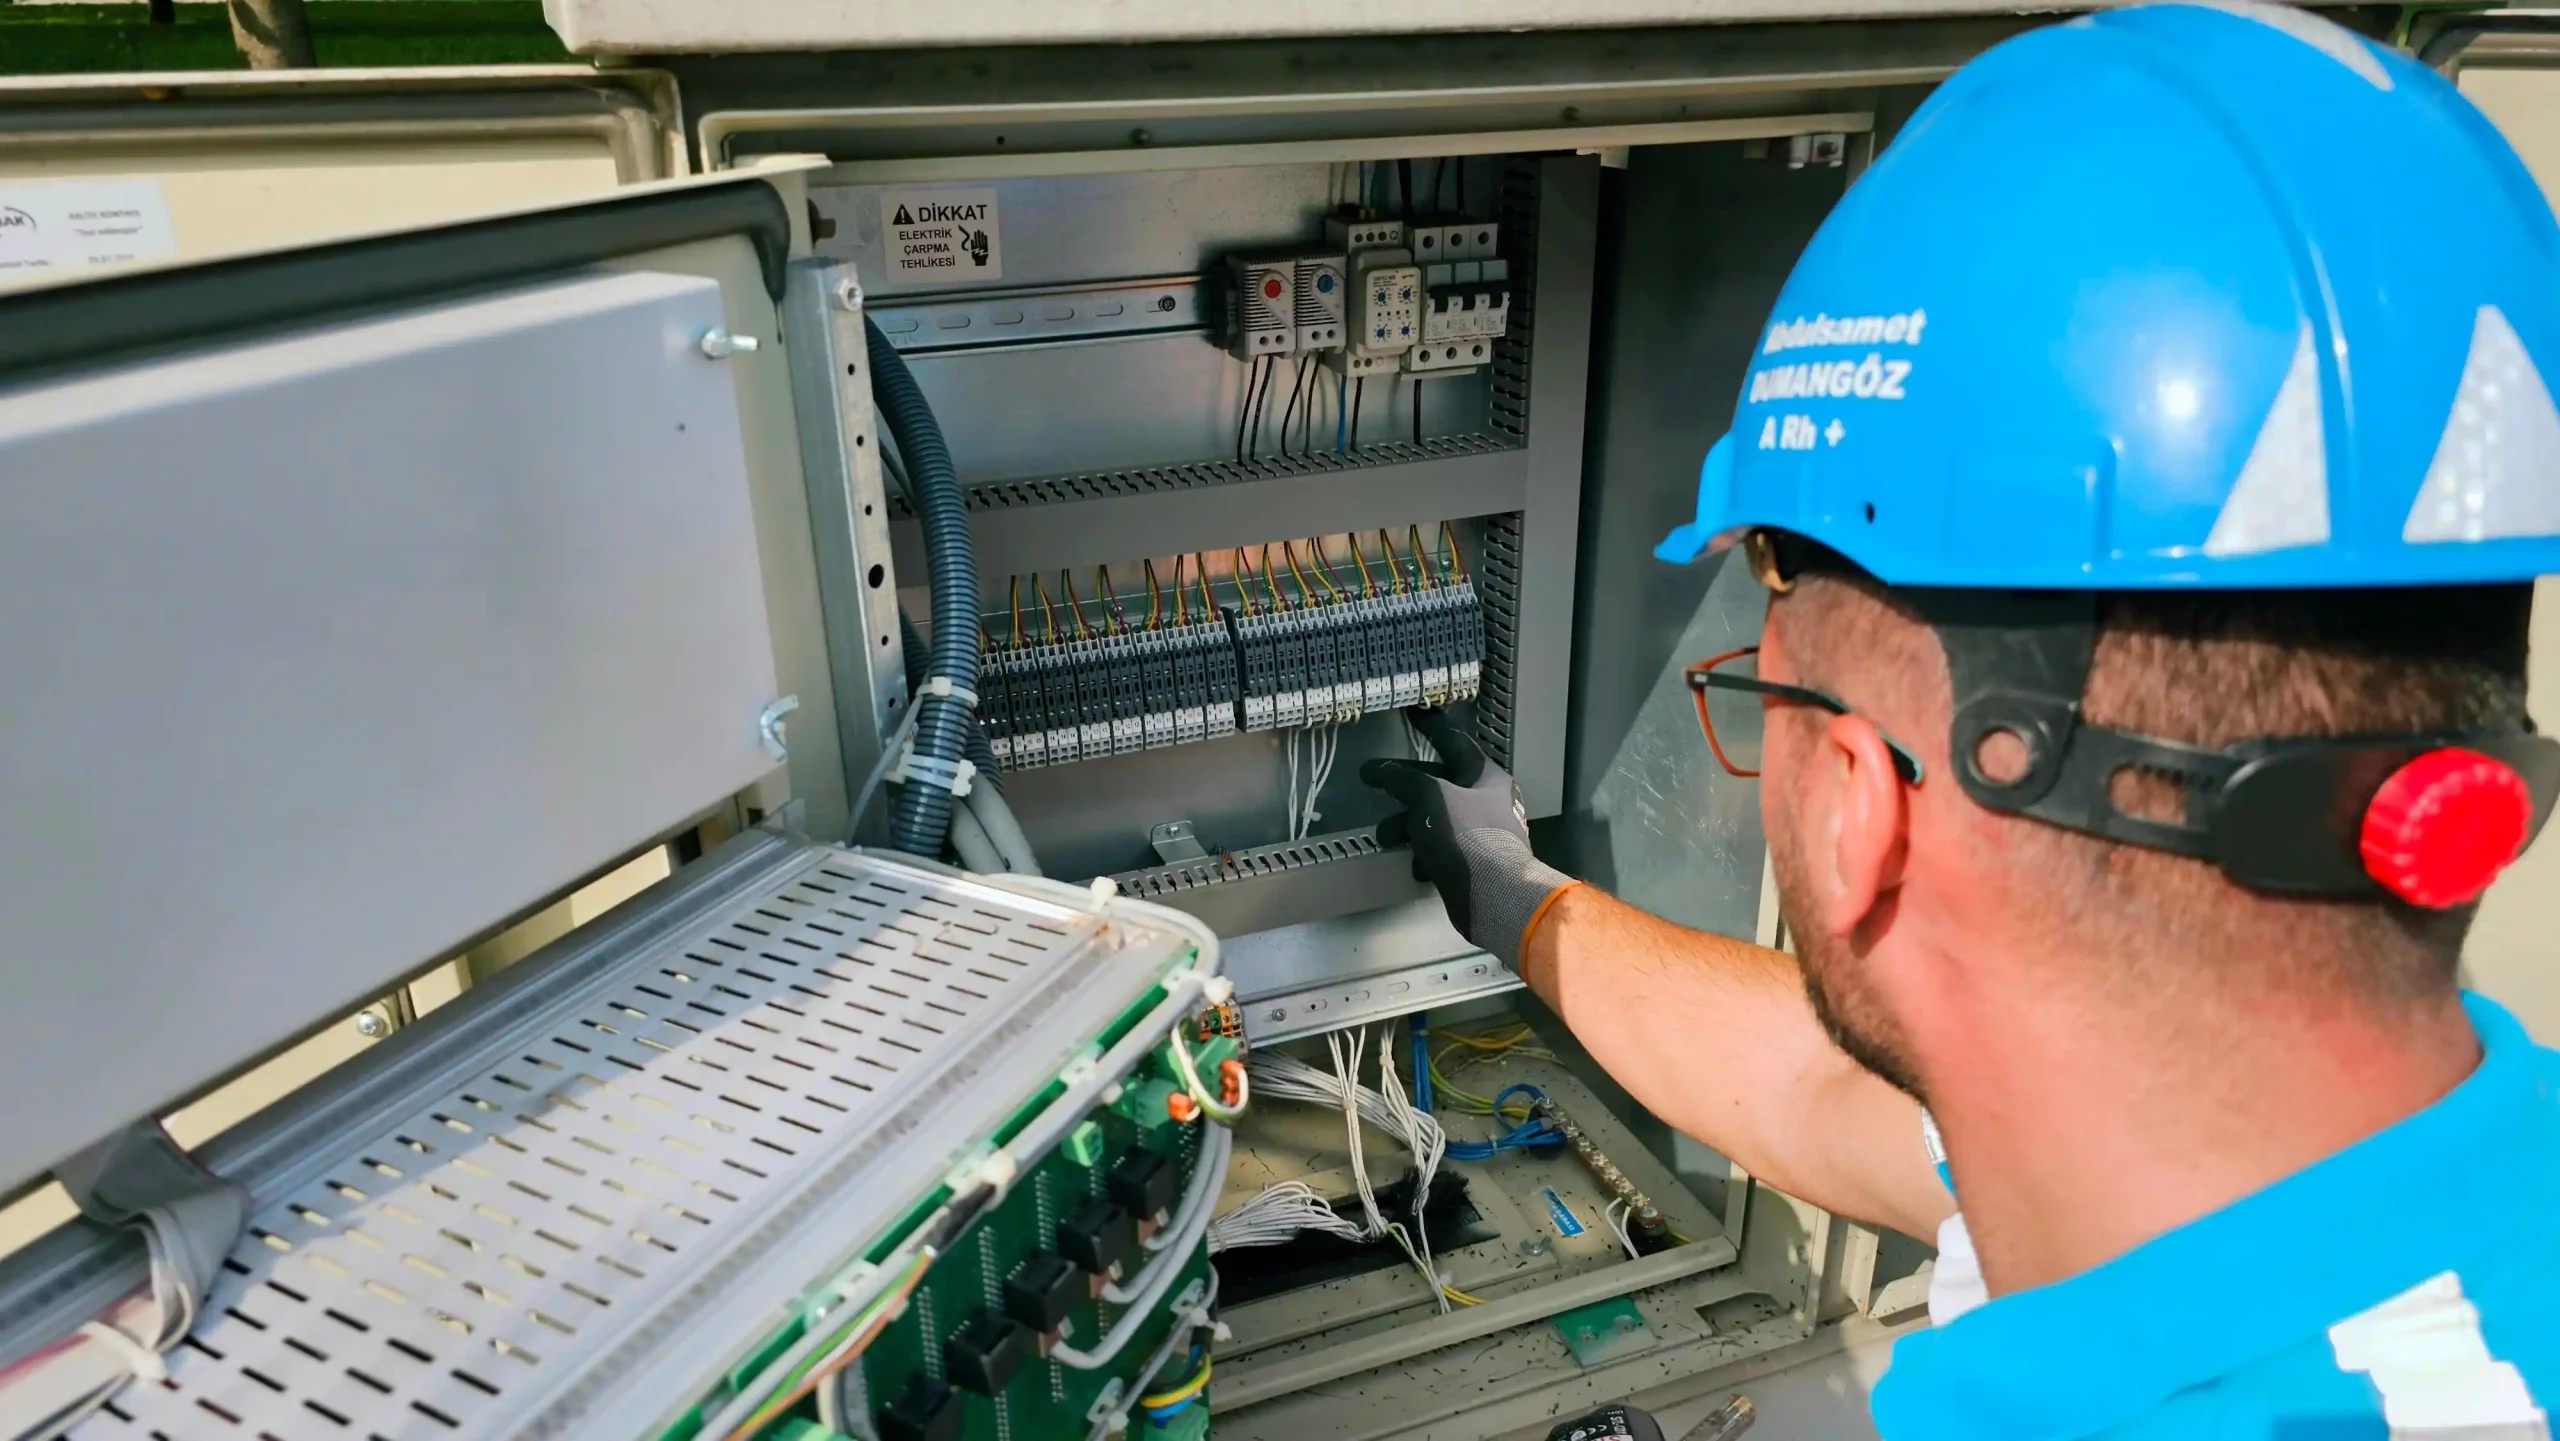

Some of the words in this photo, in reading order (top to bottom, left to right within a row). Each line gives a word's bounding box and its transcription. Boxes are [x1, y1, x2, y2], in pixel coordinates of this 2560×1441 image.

[918, 202, 988, 222] DİKKAT
[899, 227, 953, 240] ELEKTRİK
[904, 243, 950, 256] ÇARPMA
[900, 255, 956, 269] TEHLİKESİ
[1758, 415, 1777, 450] A
[1779, 413, 1818, 451] Rh
